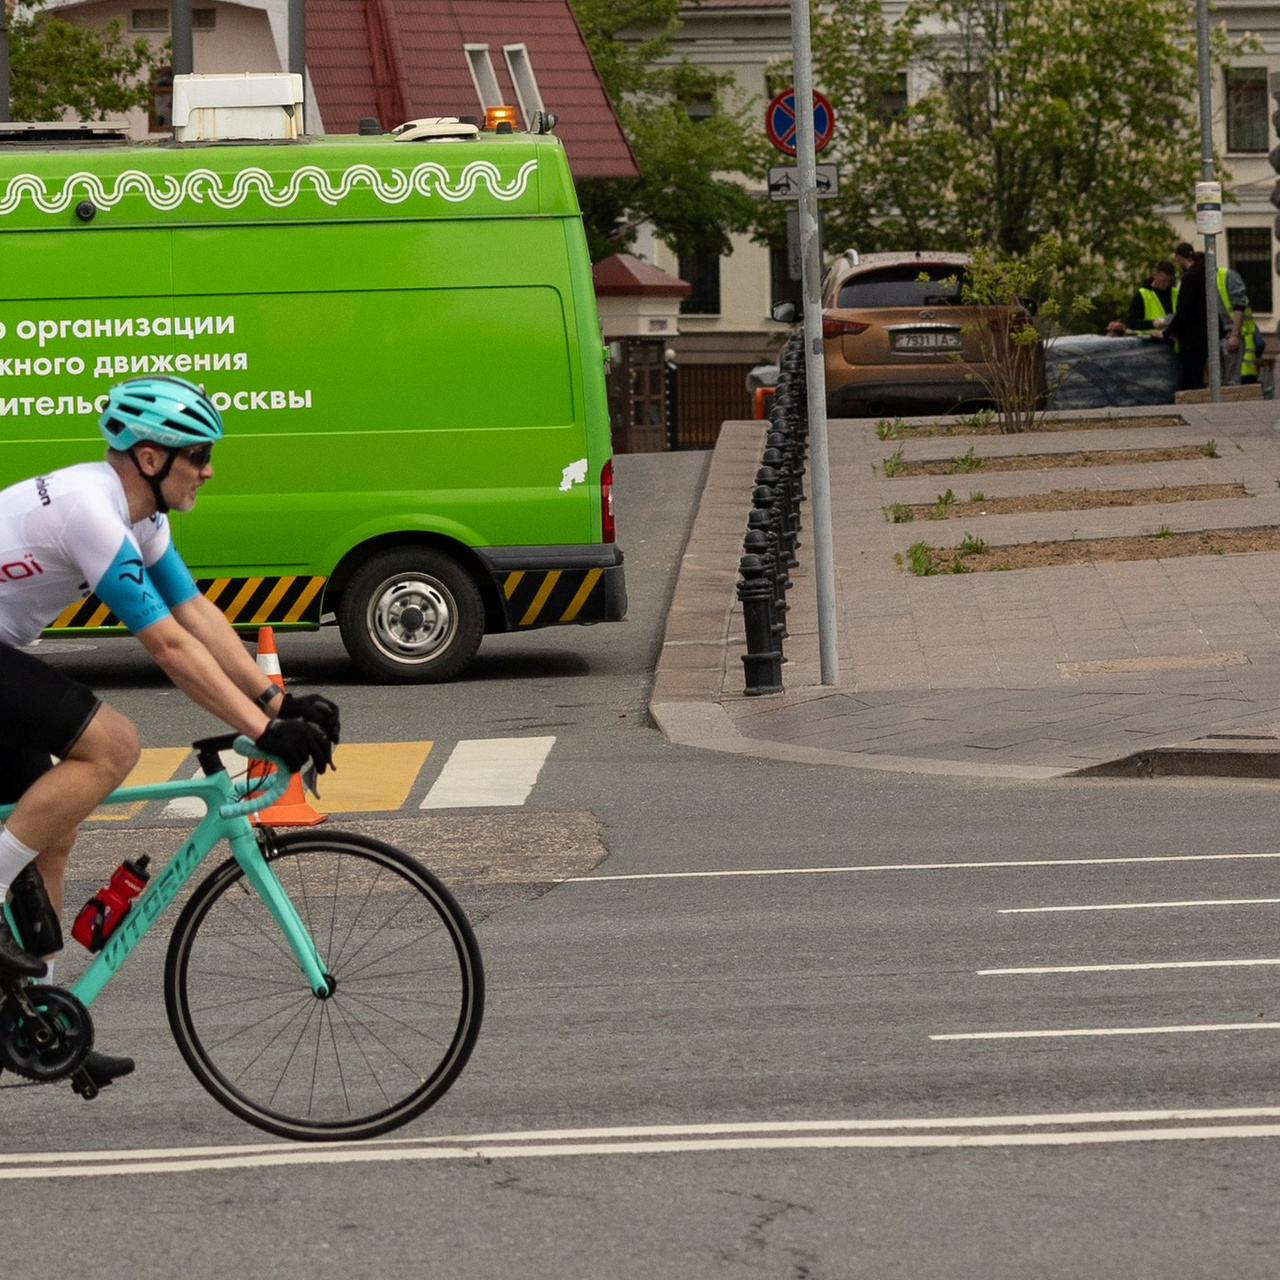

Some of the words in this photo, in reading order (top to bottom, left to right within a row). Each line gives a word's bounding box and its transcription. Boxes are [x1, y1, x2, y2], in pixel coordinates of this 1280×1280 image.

[15, 314, 236, 347] организации
[93, 352, 249, 379] движения
[197, 383, 313, 411] осквы
